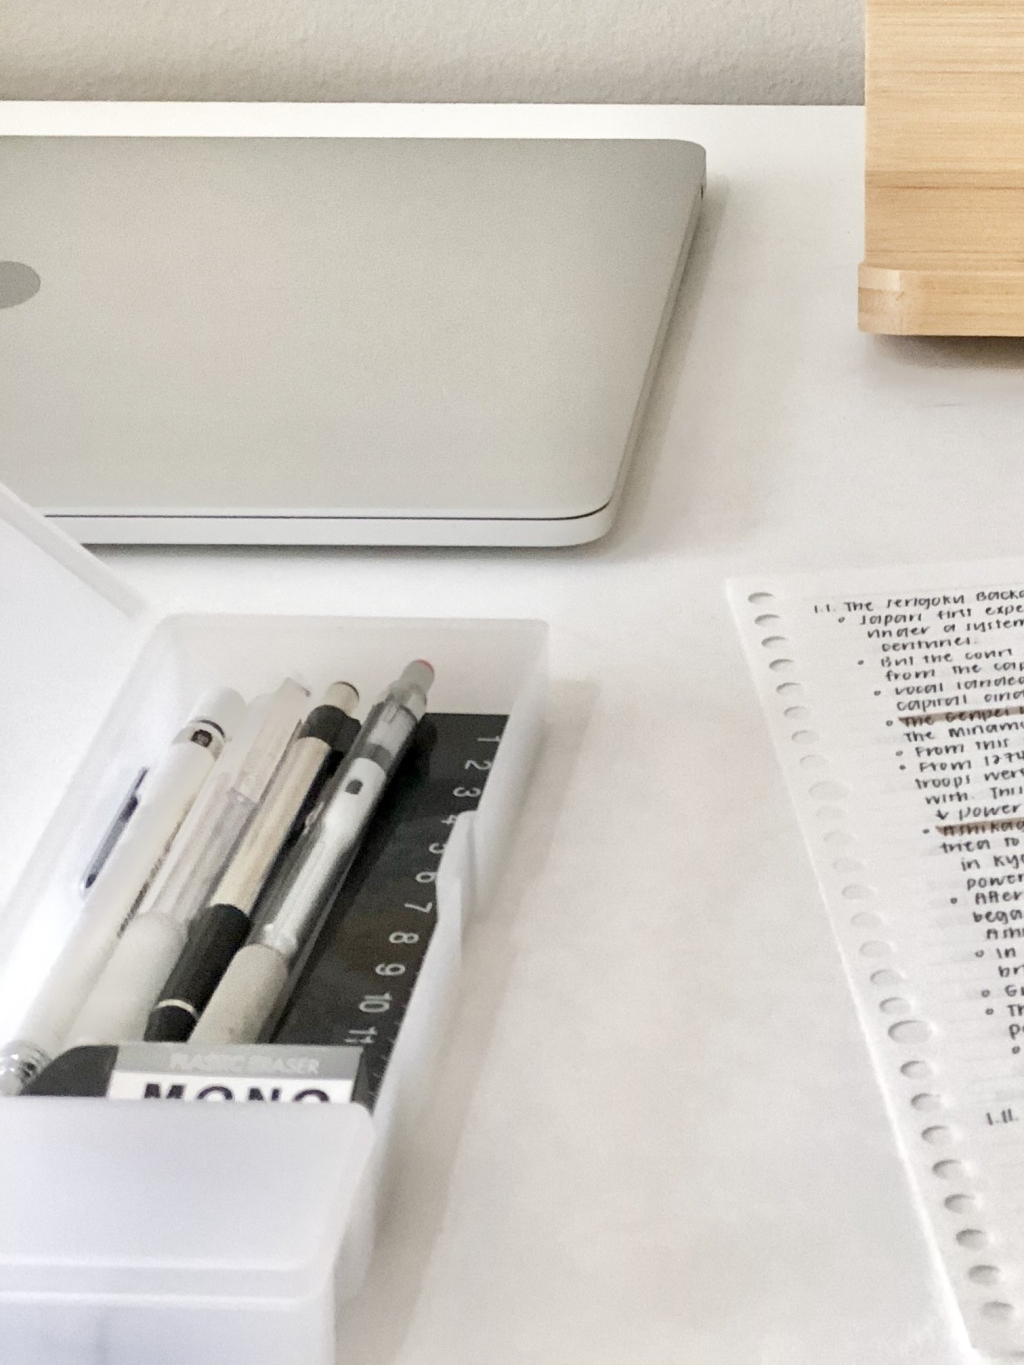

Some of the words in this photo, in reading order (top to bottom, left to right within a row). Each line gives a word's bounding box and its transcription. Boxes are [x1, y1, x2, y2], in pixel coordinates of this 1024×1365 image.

[464, 759, 492, 770] 2
[453, 786, 481, 797] 3
[959, 804, 1023, 822] power
[404, 902, 432, 913] 7
[389, 931, 419, 944] 8
[375, 963, 406, 976] 9
[358, 992, 393, 1013] 10
[345, 1026, 377, 1044] 11
